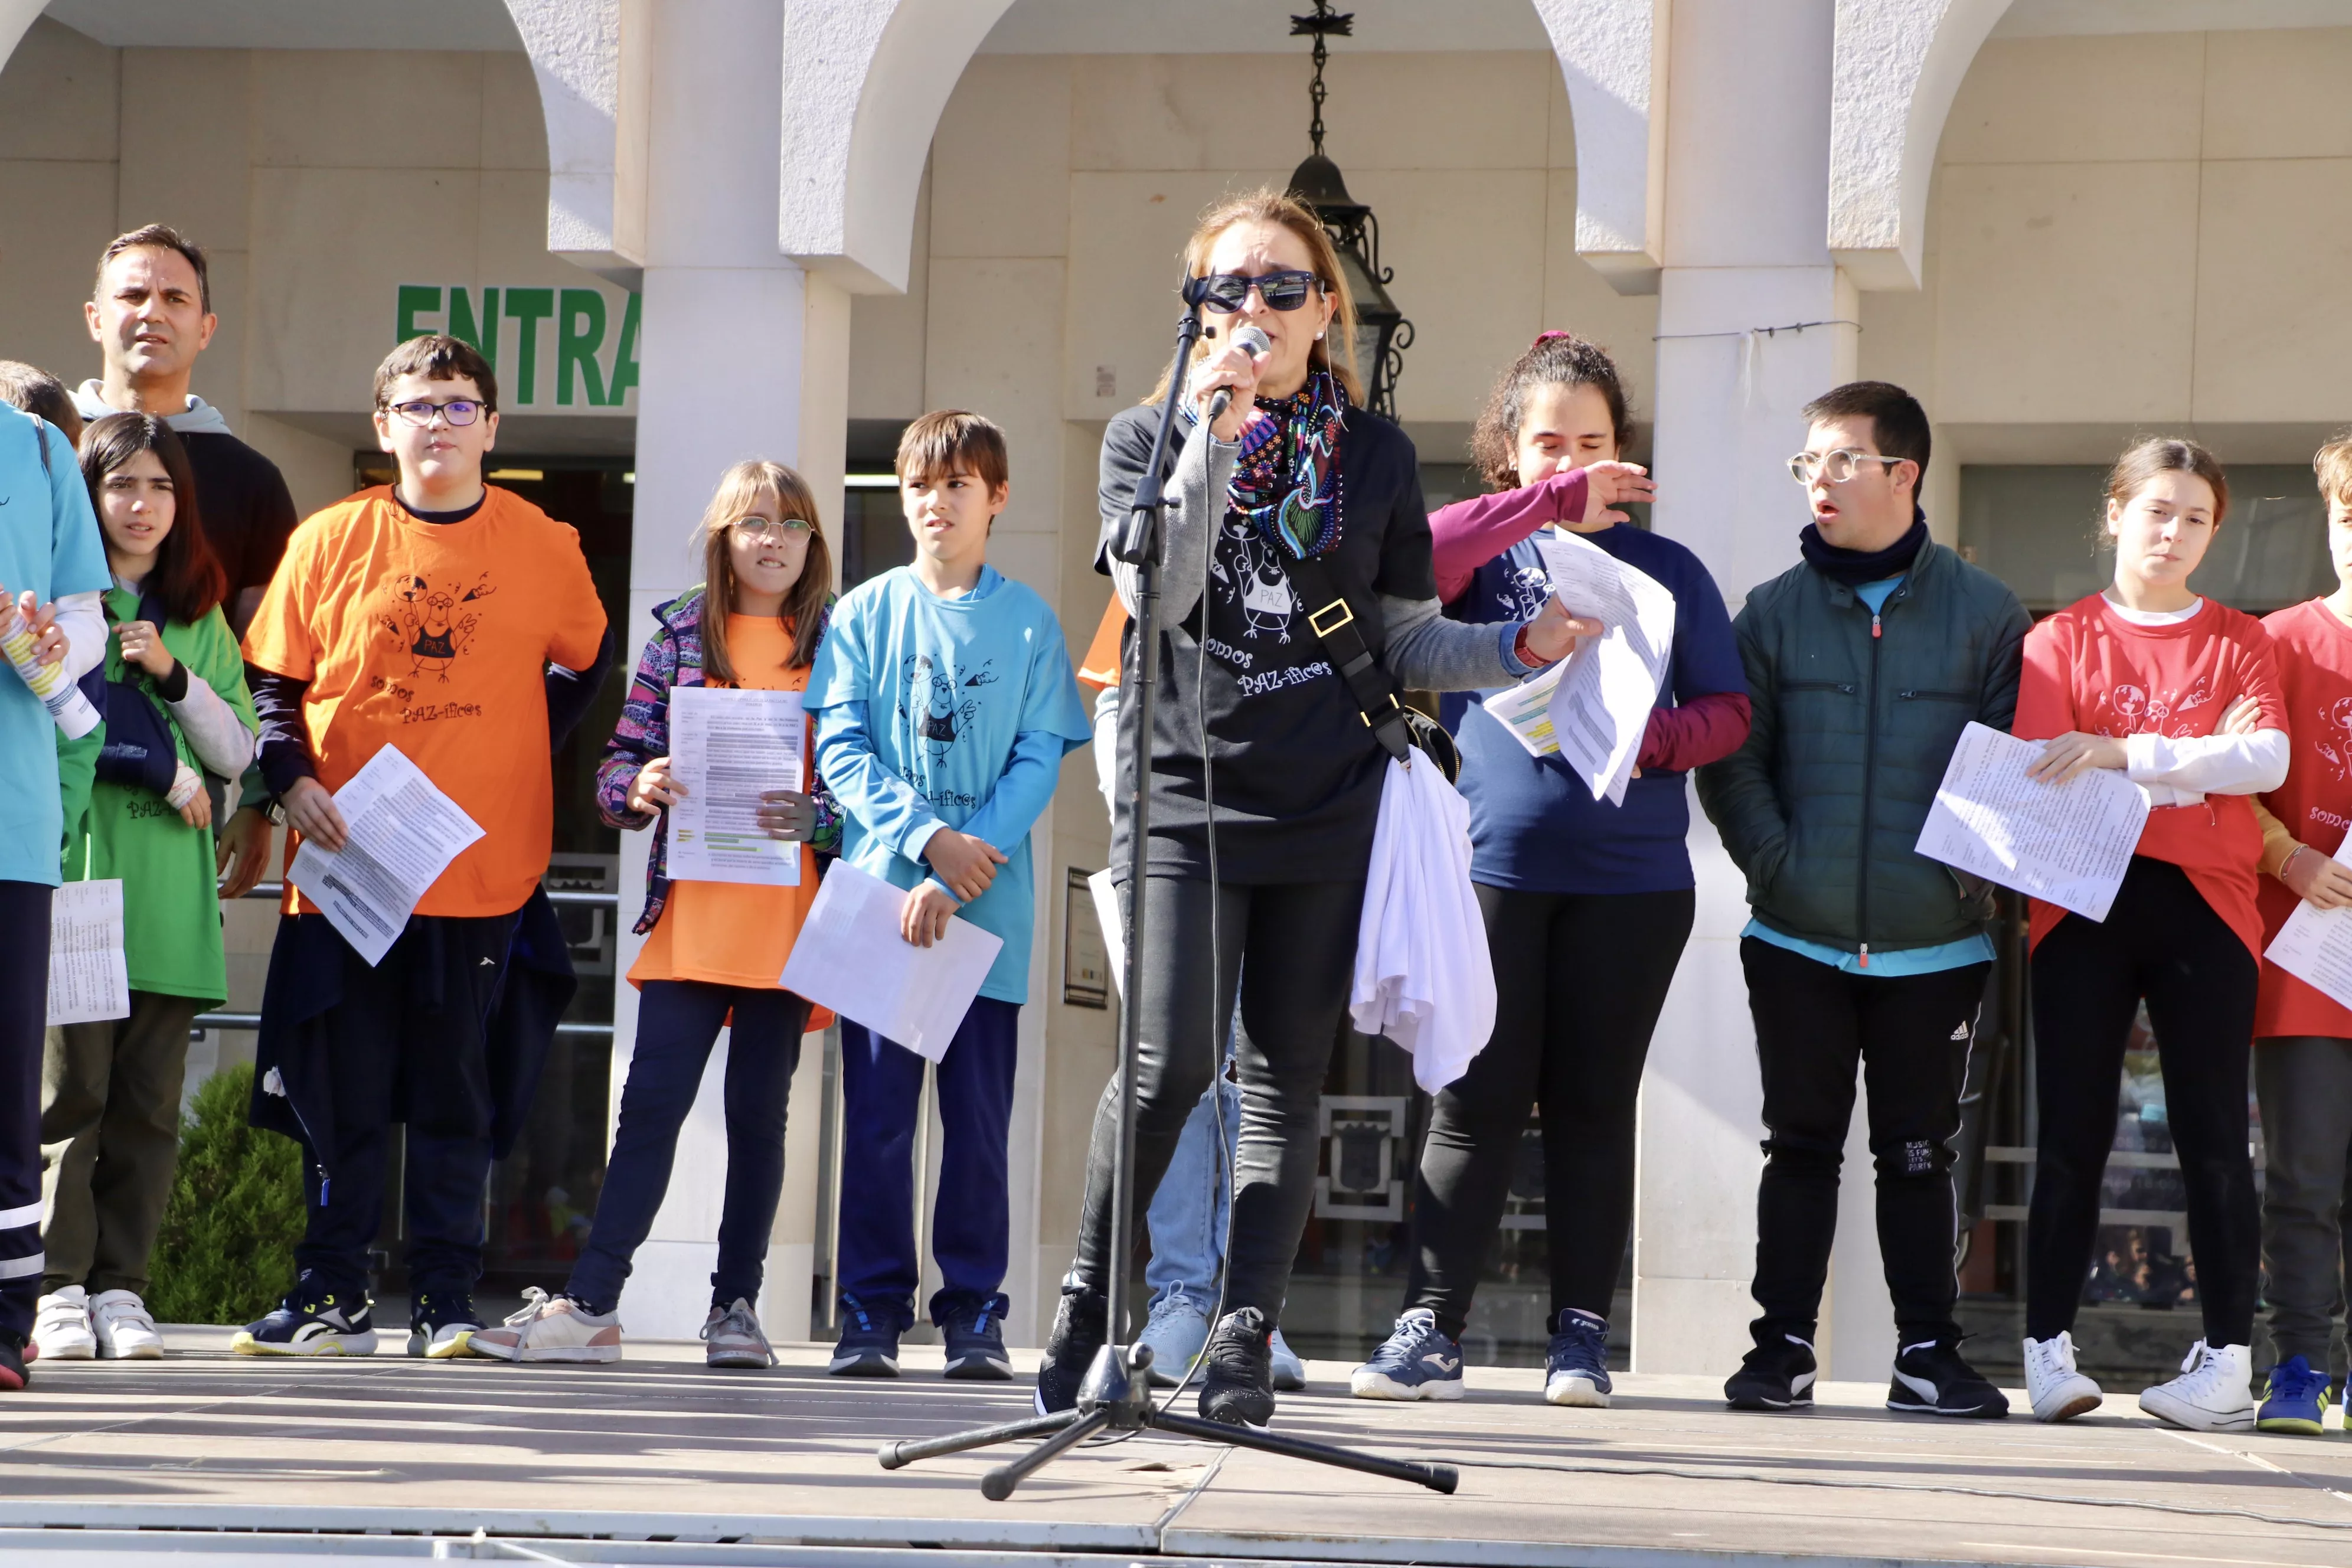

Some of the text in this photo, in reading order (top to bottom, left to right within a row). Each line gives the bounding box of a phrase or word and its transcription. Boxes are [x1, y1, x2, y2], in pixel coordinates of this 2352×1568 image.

[1260, 589, 1283, 608] PAZ
[423, 639, 446, 655] PAZ
[927, 720, 946, 737] PAZ
